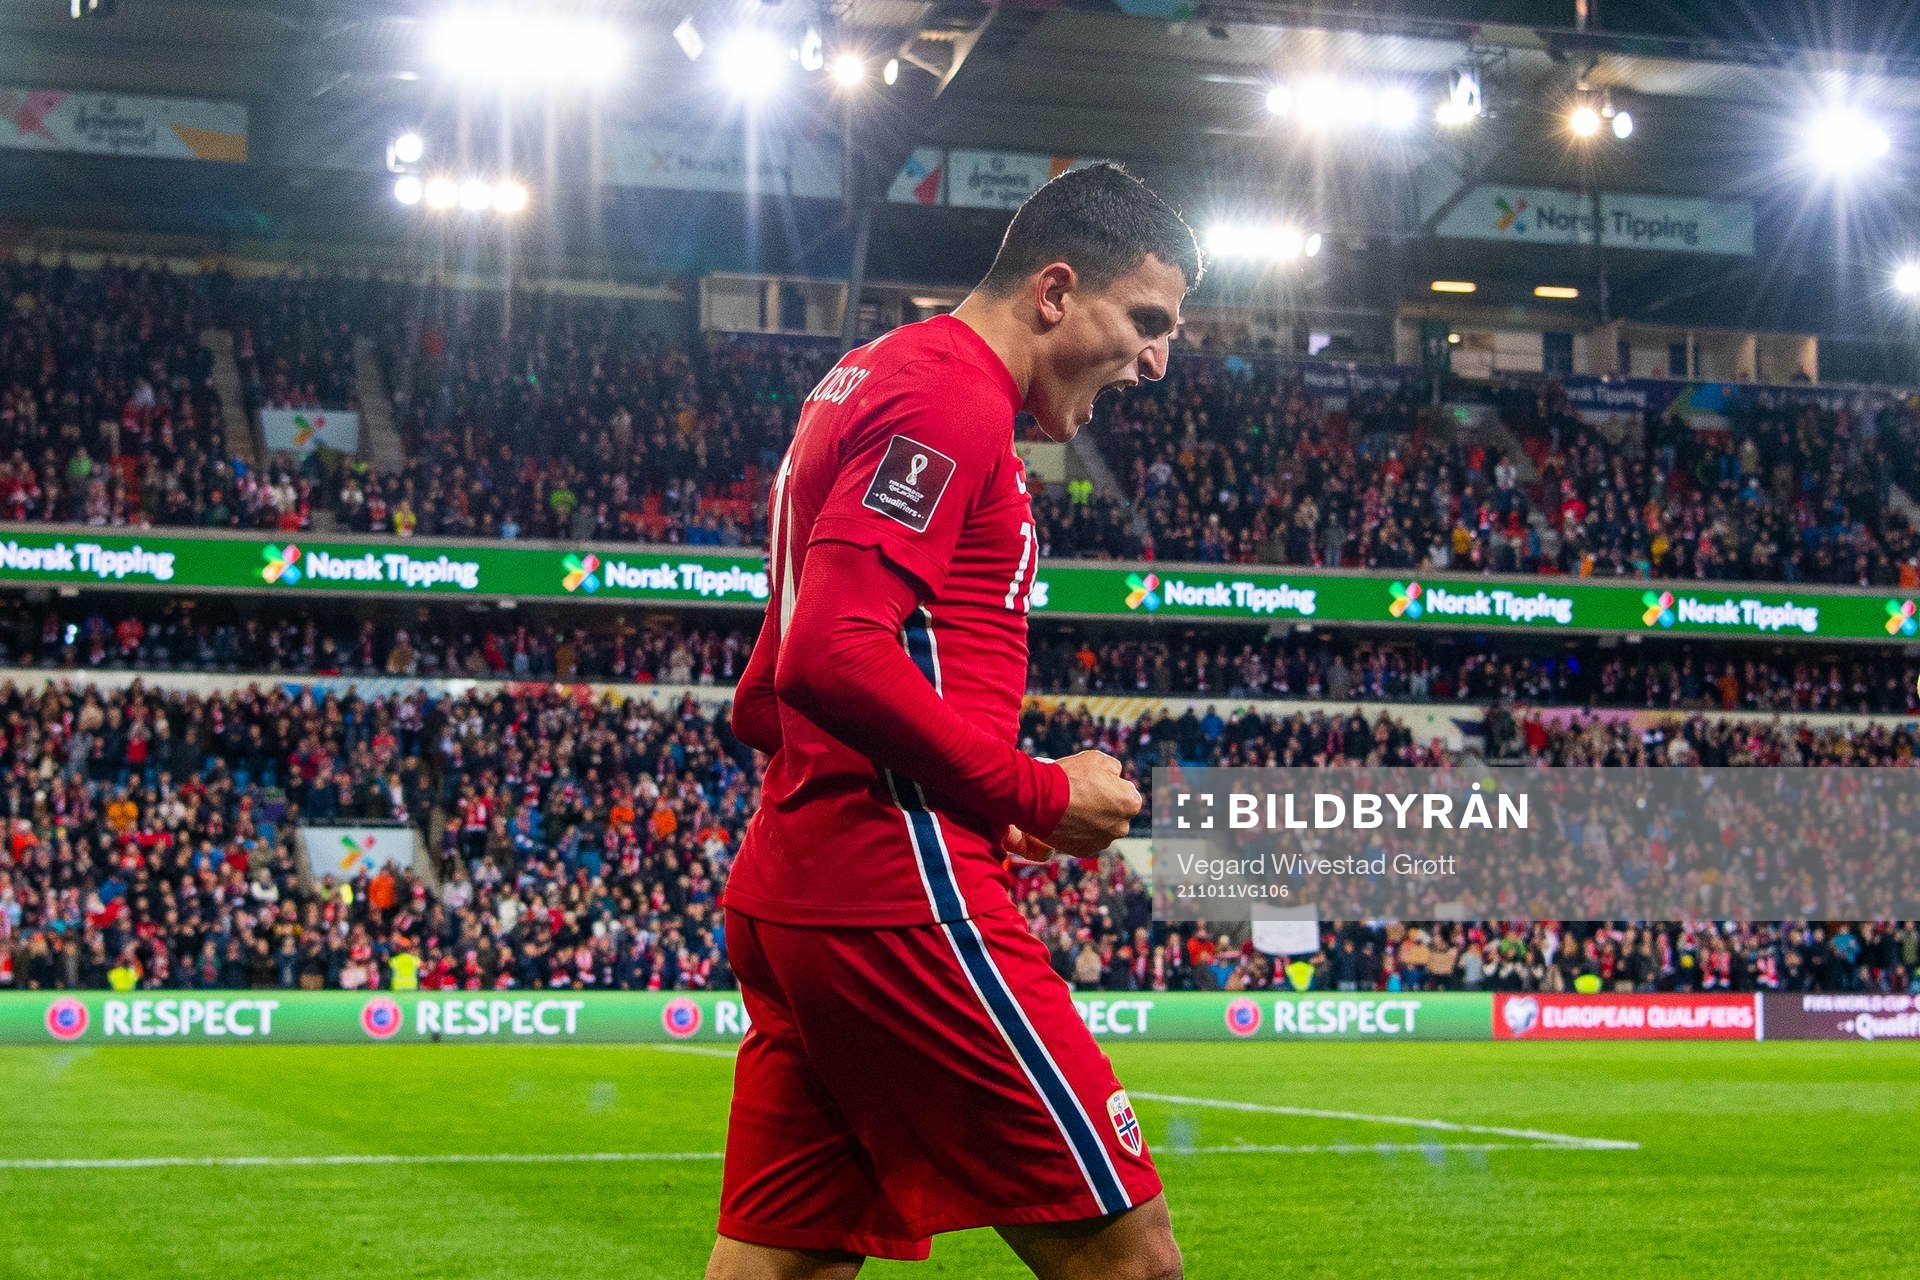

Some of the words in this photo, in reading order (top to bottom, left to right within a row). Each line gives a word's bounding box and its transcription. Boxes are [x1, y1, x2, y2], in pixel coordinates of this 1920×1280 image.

[1612, 210, 1699, 245] Tipping
[879, 493, 917, 516] Qualifiers
[74, 543, 175, 581] Tipping
[305, 551, 384, 580] Norsk
[384, 553, 479, 589] Tipping
[604, 561, 679, 589] Norsk
[678, 564, 769, 598] Tipping
[1164, 580, 1232, 607] Norsk
[1231, 582, 1317, 615] Tipping
[1426, 589, 1491, 615] Norsk
[1491, 591, 1573, 624] Tipping
[1678, 598, 1740, 624] Norsk
[1740, 600, 1818, 633] Tipping
[104, 1000, 279, 1035] RESPECT
[416, 1000, 585, 1035] RESPECT
[1274, 1000, 1422, 1033] RESPECT
[1542, 1006, 1645, 1028] EUROPEAN
[1647, 1006, 1753, 1028] QUALIFIERS
[1803, 995, 1833, 1012] FIFA
[1833, 995, 1882, 1012] WORLD
[1882, 995, 1912, 1012] CUP
